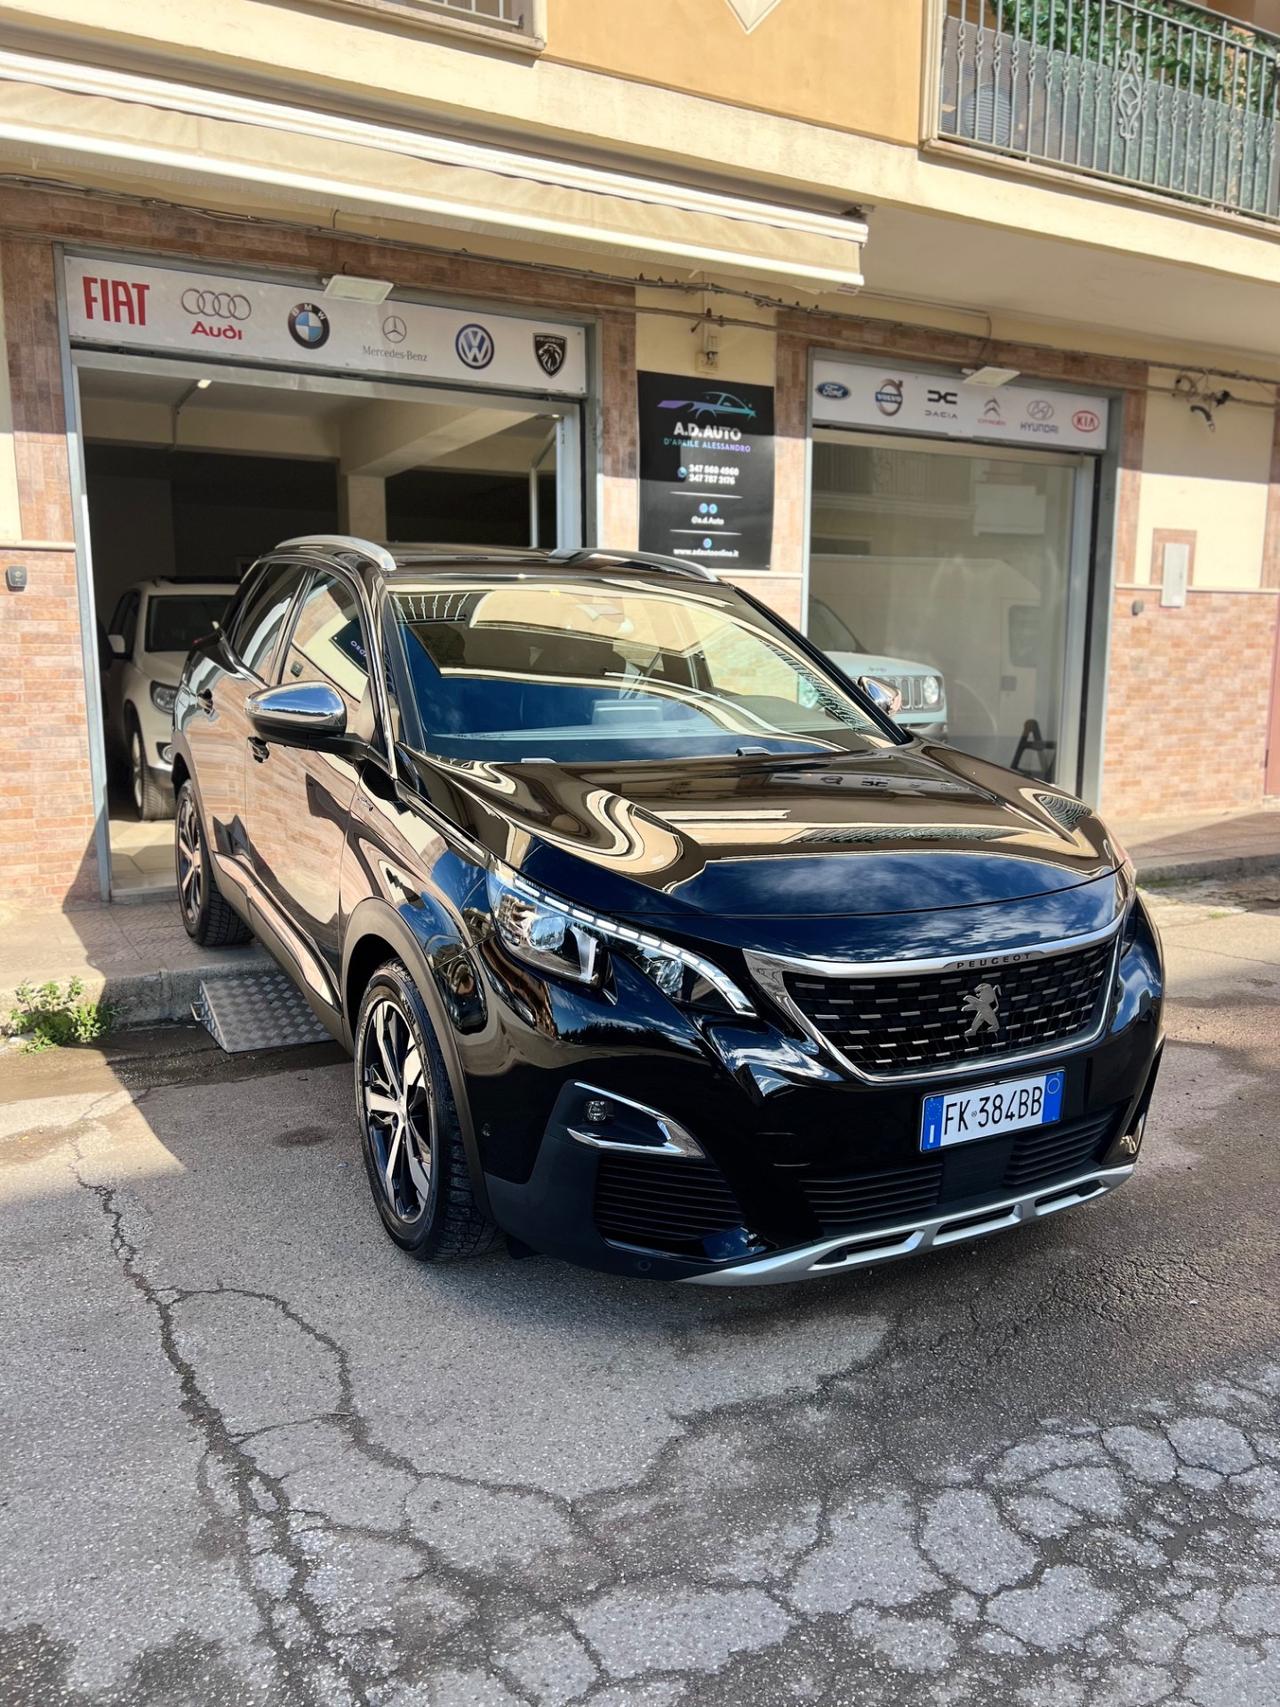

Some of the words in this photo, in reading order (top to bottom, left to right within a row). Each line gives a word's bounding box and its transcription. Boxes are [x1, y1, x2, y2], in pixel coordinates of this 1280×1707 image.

[82, 276, 150, 326] FIAT
[191, 321, 243, 340] Audi
[362, 345, 428, 362] Mercedes-Benz
[924, 409, 958, 419] DACIA
[1020, 422, 1059, 434] HYUNDAI
[1076, 415, 1096, 428] KIA
[702, 440, 751, 453] ALESSANDRO
[956, 953, 1031, 969] PEUGEOT
